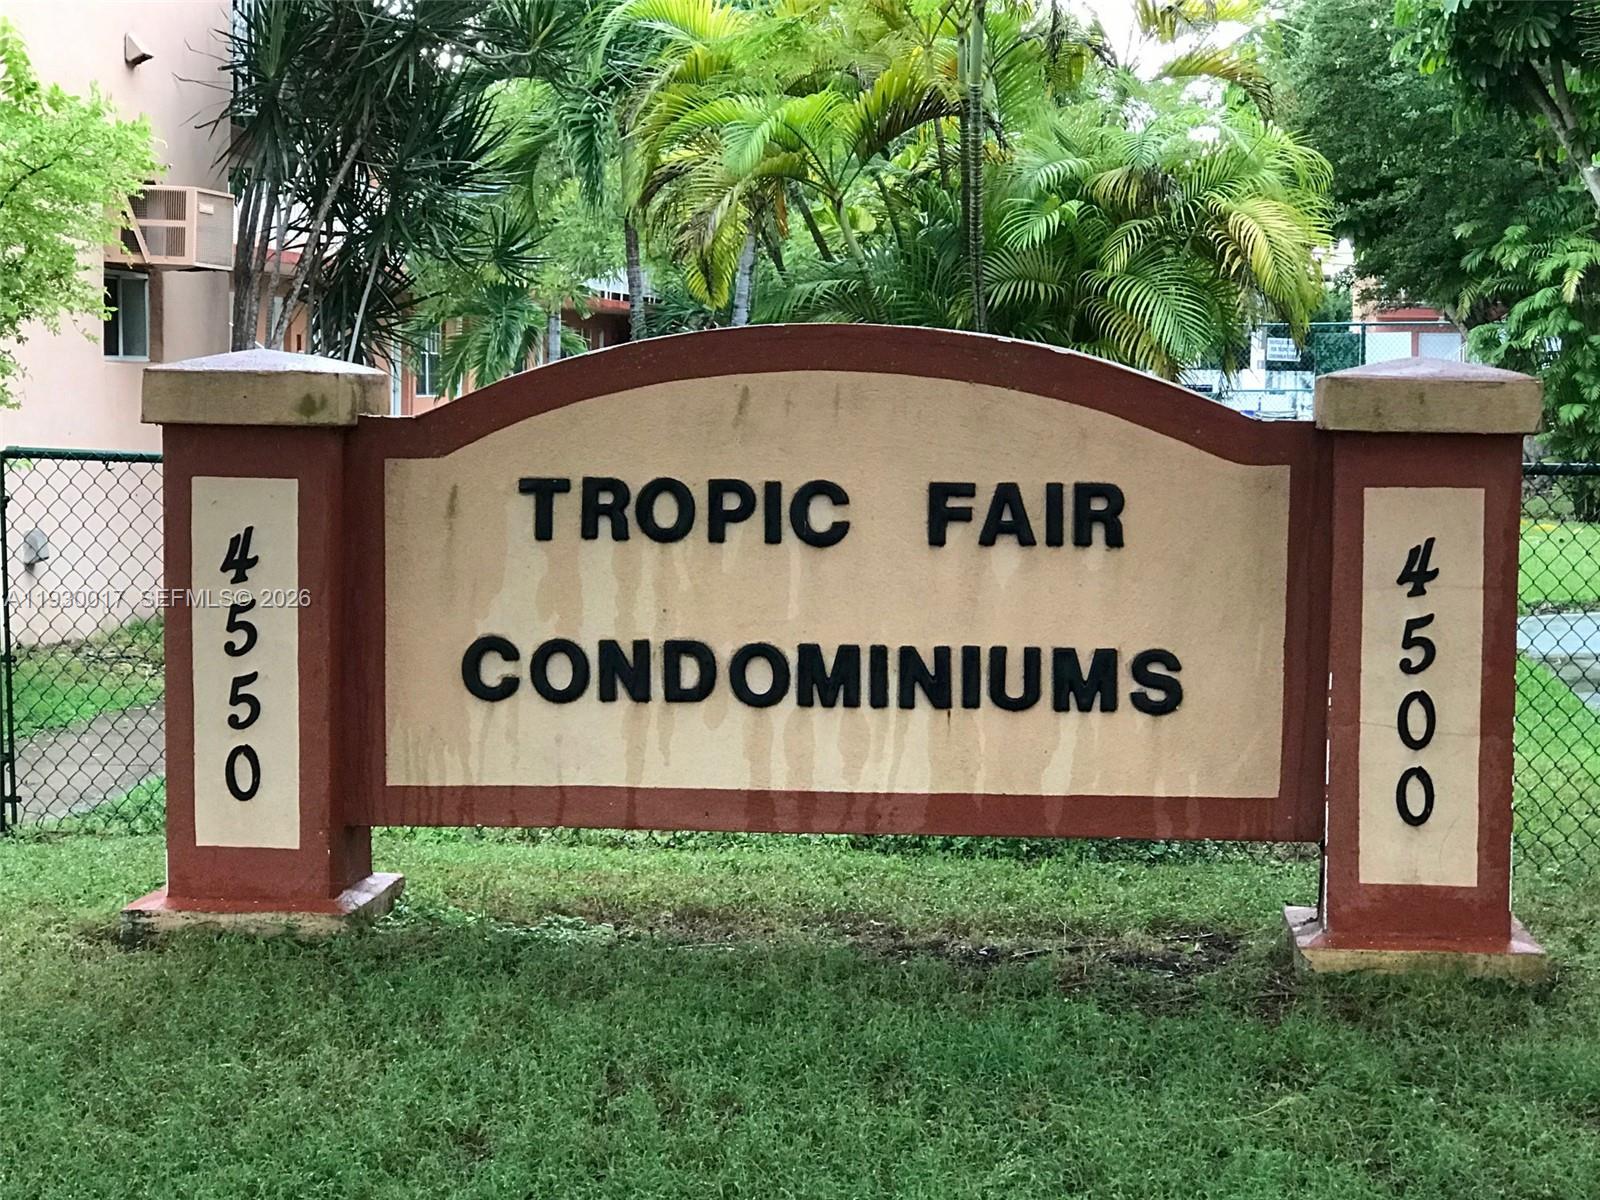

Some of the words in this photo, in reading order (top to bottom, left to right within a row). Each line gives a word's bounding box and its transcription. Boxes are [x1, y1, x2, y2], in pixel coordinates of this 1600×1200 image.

[518, 476, 850, 549] TROPIC
[926, 481, 1125, 549] FAIR
[219, 526, 261, 802] 4550
[461, 634, 1184, 717] CONDOMINIUMS
[1395, 536, 1440, 827] 4500
